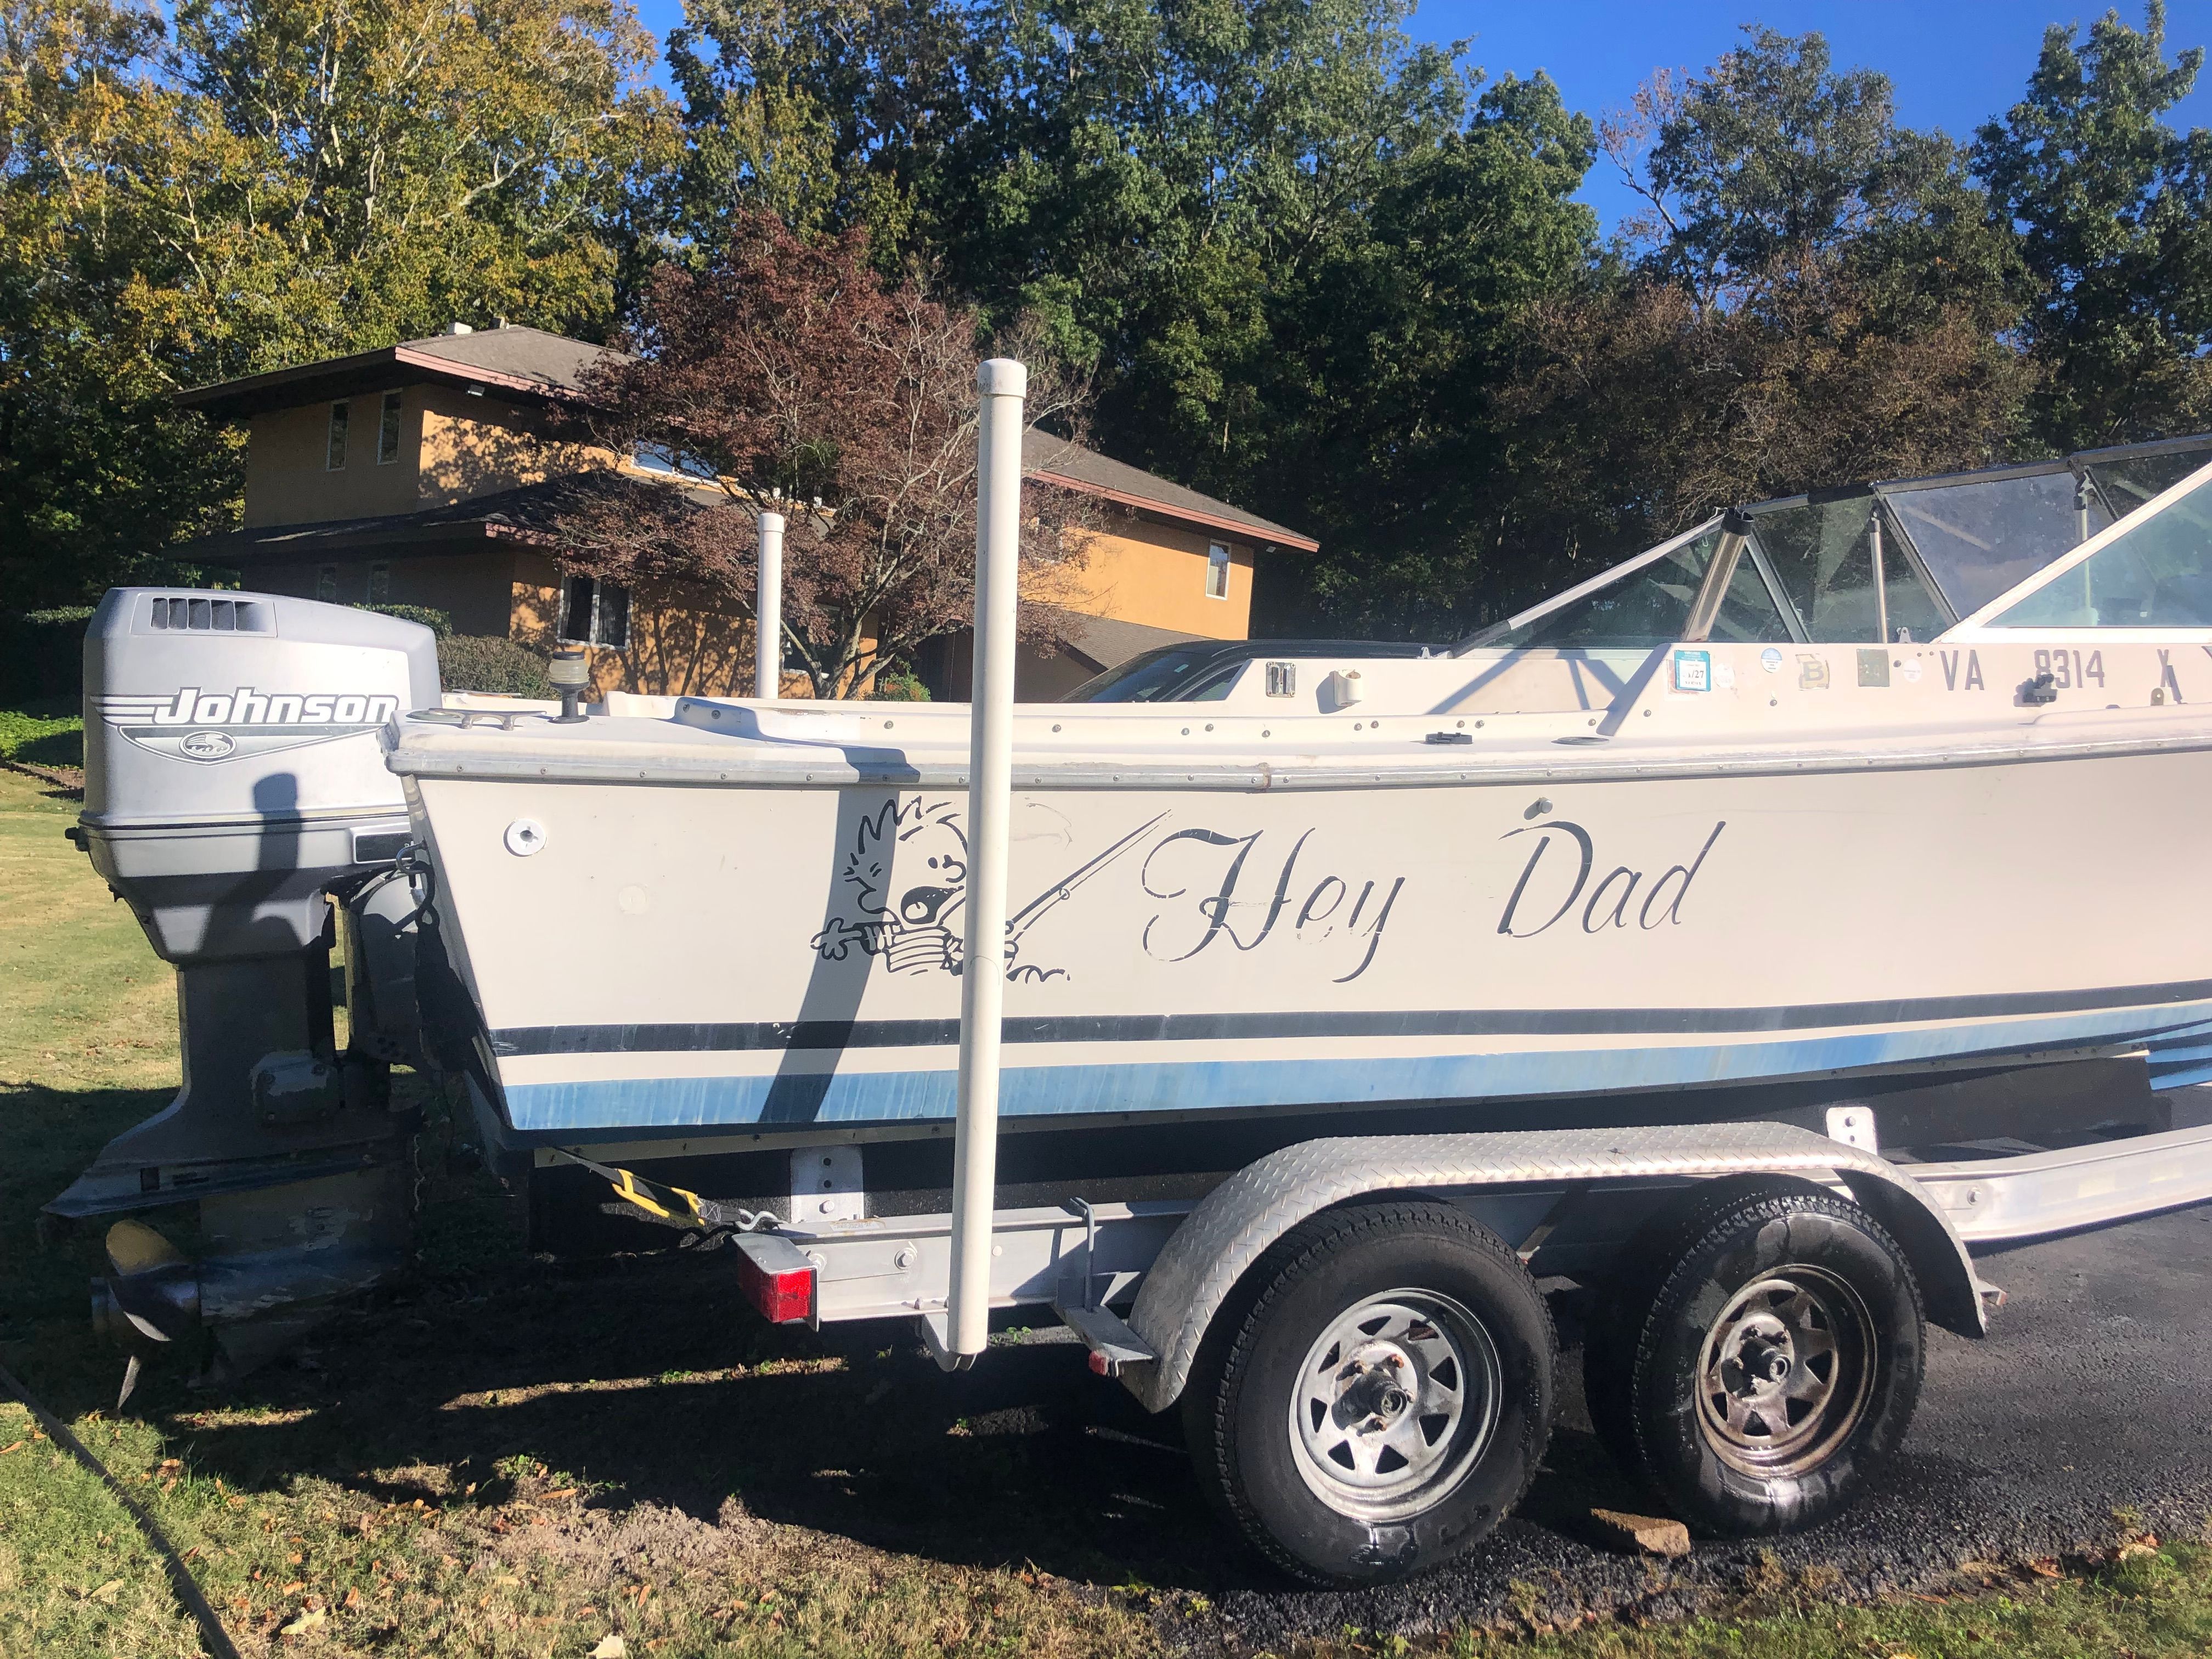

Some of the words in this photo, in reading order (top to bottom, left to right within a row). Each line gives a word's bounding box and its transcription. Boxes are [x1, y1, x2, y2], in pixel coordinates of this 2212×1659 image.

[1939, 650, 1984, 691] VA
[2034, 649, 2105, 689] 8314
[2157, 649, 2172, 687] X
[154, 687, 399, 724] Johnson
[1142, 827, 1406, 983] Hey
[1497, 821, 1726, 938] Dad
